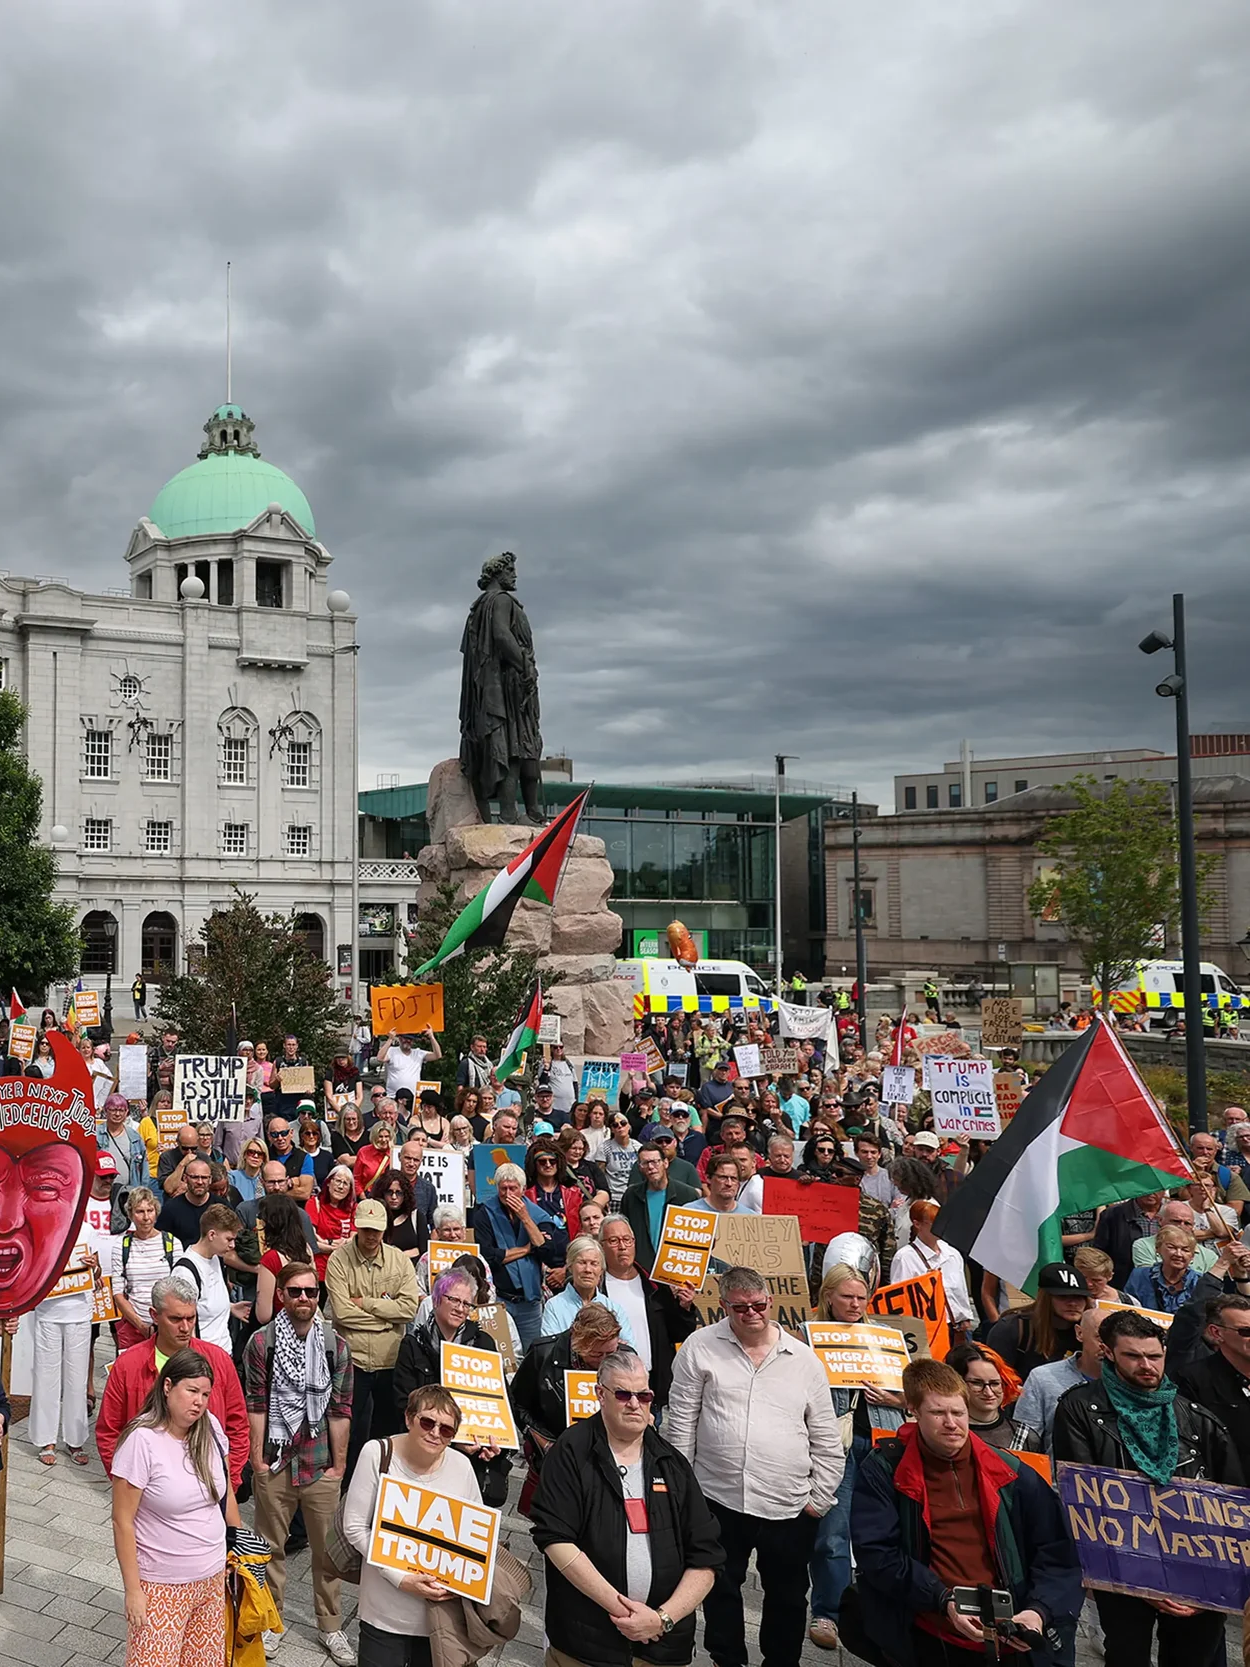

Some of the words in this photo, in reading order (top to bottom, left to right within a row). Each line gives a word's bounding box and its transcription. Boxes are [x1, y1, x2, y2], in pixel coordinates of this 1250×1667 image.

[378, 992, 438, 1020] FDJT
[791, 1008, 815, 1016] STOP
[984, 1007, 1018, 1015] PLACE
[983, 1020, 1020, 1028] FASCISM
[982, 1034, 1020, 1044] SCOTLAND
[760, 1050, 780, 1058] TOLD
[179, 1058, 245, 1079] TRUMP
[180, 1081, 196, 1100] IS
[200, 1080, 243, 1100] STILL
[28, 1083, 69, 1105] NEXT
[65, 1088, 98, 1137] JOBBY
[162, 1114, 183, 1122] STOP
[197, 1100, 244, 1120] CUNT
[160, 1122, 187, 1130] TRUMP
[438, 1156, 448, 1168] IS
[674, 1215, 710, 1230] STOP
[666, 1227, 712, 1244] TRUMP
[436, 1248, 472, 1259] STOP
[668, 1248, 703, 1264] FREE
[726, 1244, 783, 1269] WAS
[662, 1261, 701, 1277] GAZA
[54, 1272, 90, 1292] UMP
[770, 1277, 802, 1296] THE
[1058, 1270, 1080, 1288] VA
[104, 1286, 112, 1310] STOP
[812, 1331, 851, 1344] STOP
[854, 1332, 902, 1348] TRUMP
[450, 1354, 493, 1372] STOP
[824, 1350, 902, 1366] MIGRANTS
[830, 1363, 902, 1377] WELCOME
[444, 1371, 502, 1392] TRUMP
[455, 1396, 500, 1414] FREE
[1074, 1474, 1131, 1511] NO
[380, 1482, 492, 1552] NAE
[1069, 1504, 1125, 1546] NO
[376, 1536, 484, 1585] TRUMP
